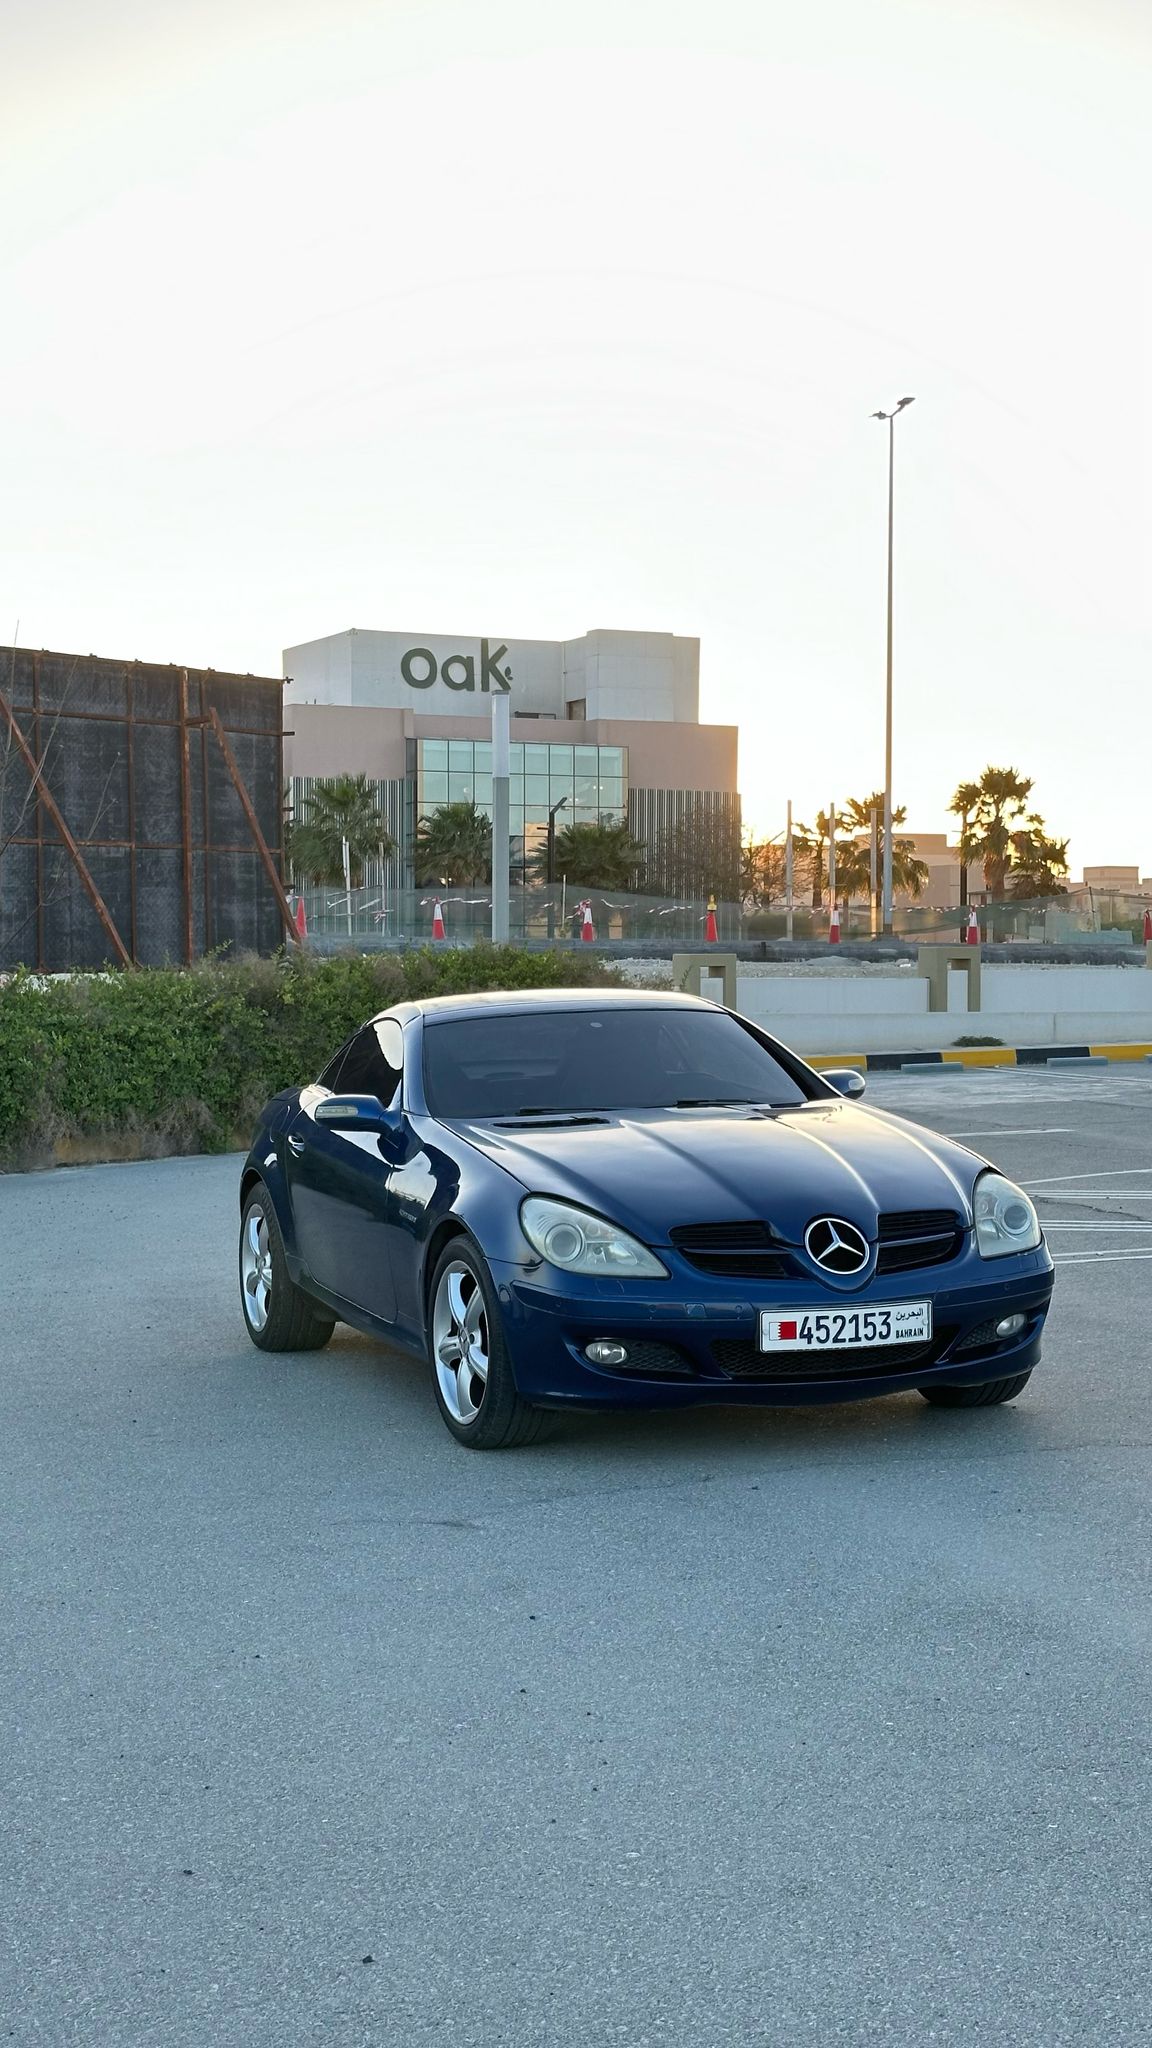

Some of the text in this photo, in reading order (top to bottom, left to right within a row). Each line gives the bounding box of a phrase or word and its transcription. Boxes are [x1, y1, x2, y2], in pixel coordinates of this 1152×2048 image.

[401, 639, 511, 692] oak
[896, 1308, 923, 1320] البحرين
[799, 1311, 891, 1344] 452153
[896, 1328, 923, 1338] BAHRAIN
